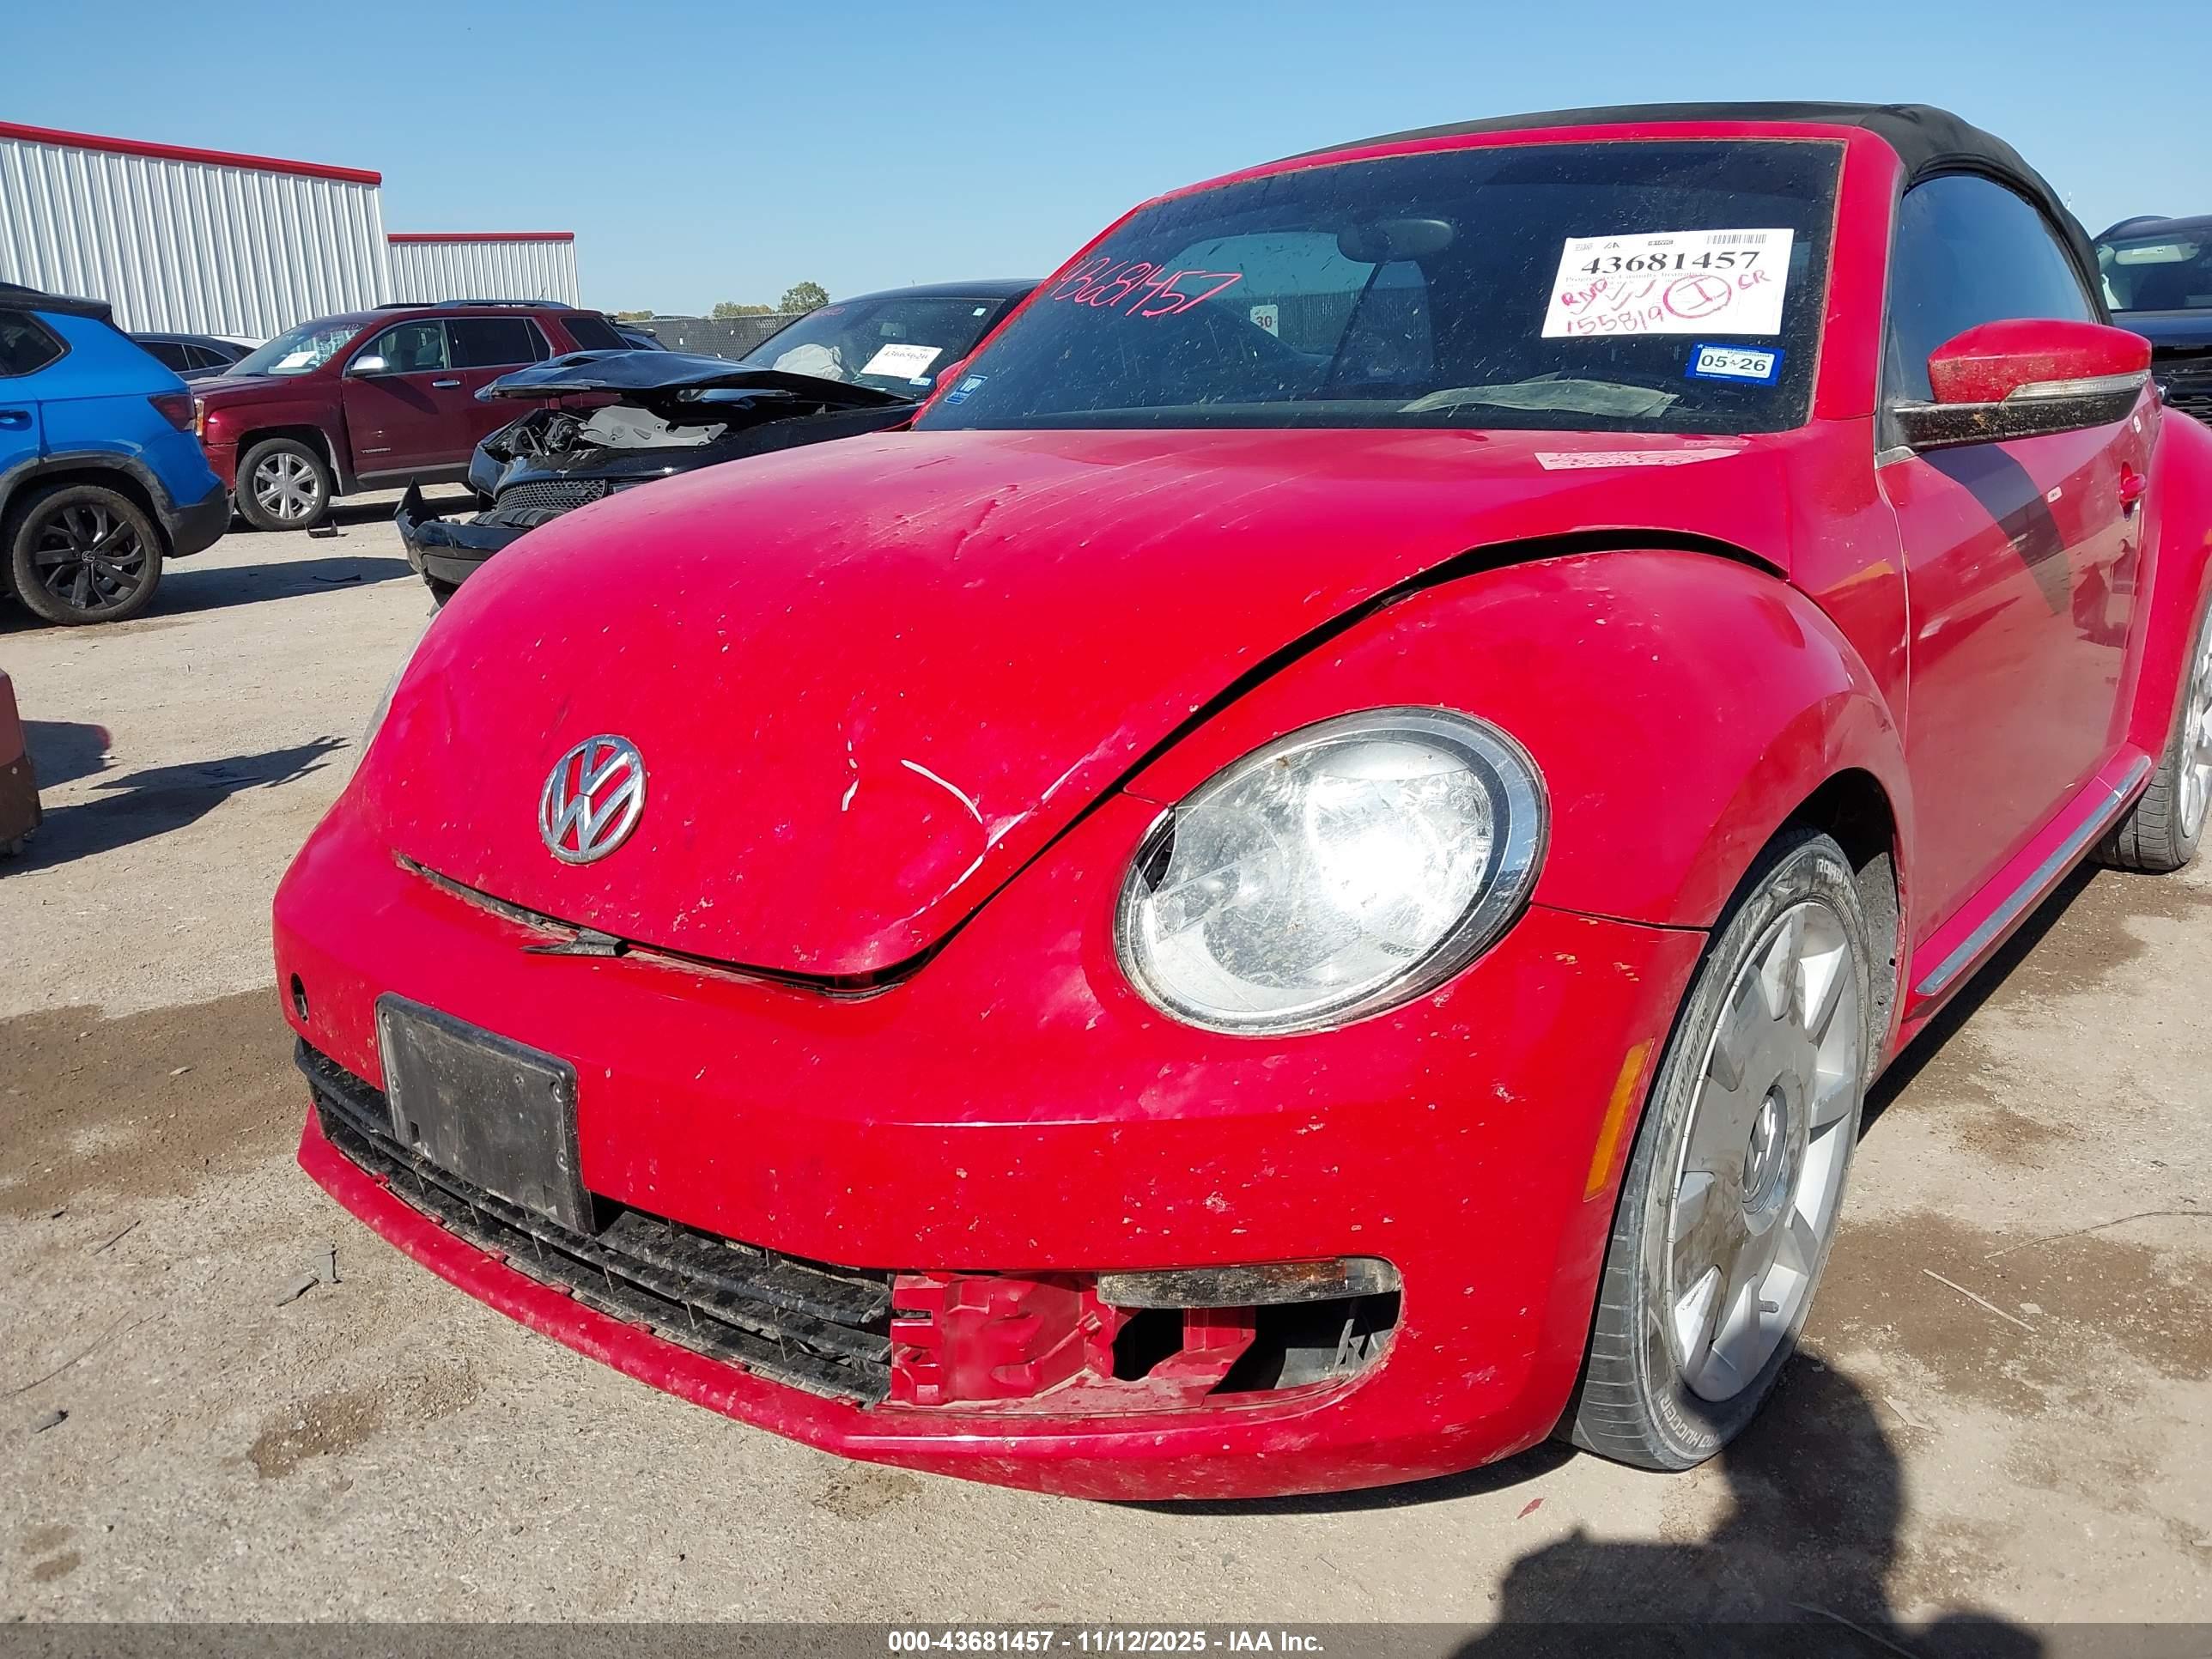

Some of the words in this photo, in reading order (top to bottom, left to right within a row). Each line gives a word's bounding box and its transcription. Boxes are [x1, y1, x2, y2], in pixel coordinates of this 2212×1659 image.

[1581, 252, 1760, 274] 43681457
[1256, 315, 1273, 328] 30
[1566, 307, 1664, 335] 155819
[1701, 355, 1729, 368] 05
[1739, 358, 1767, 372] 26
